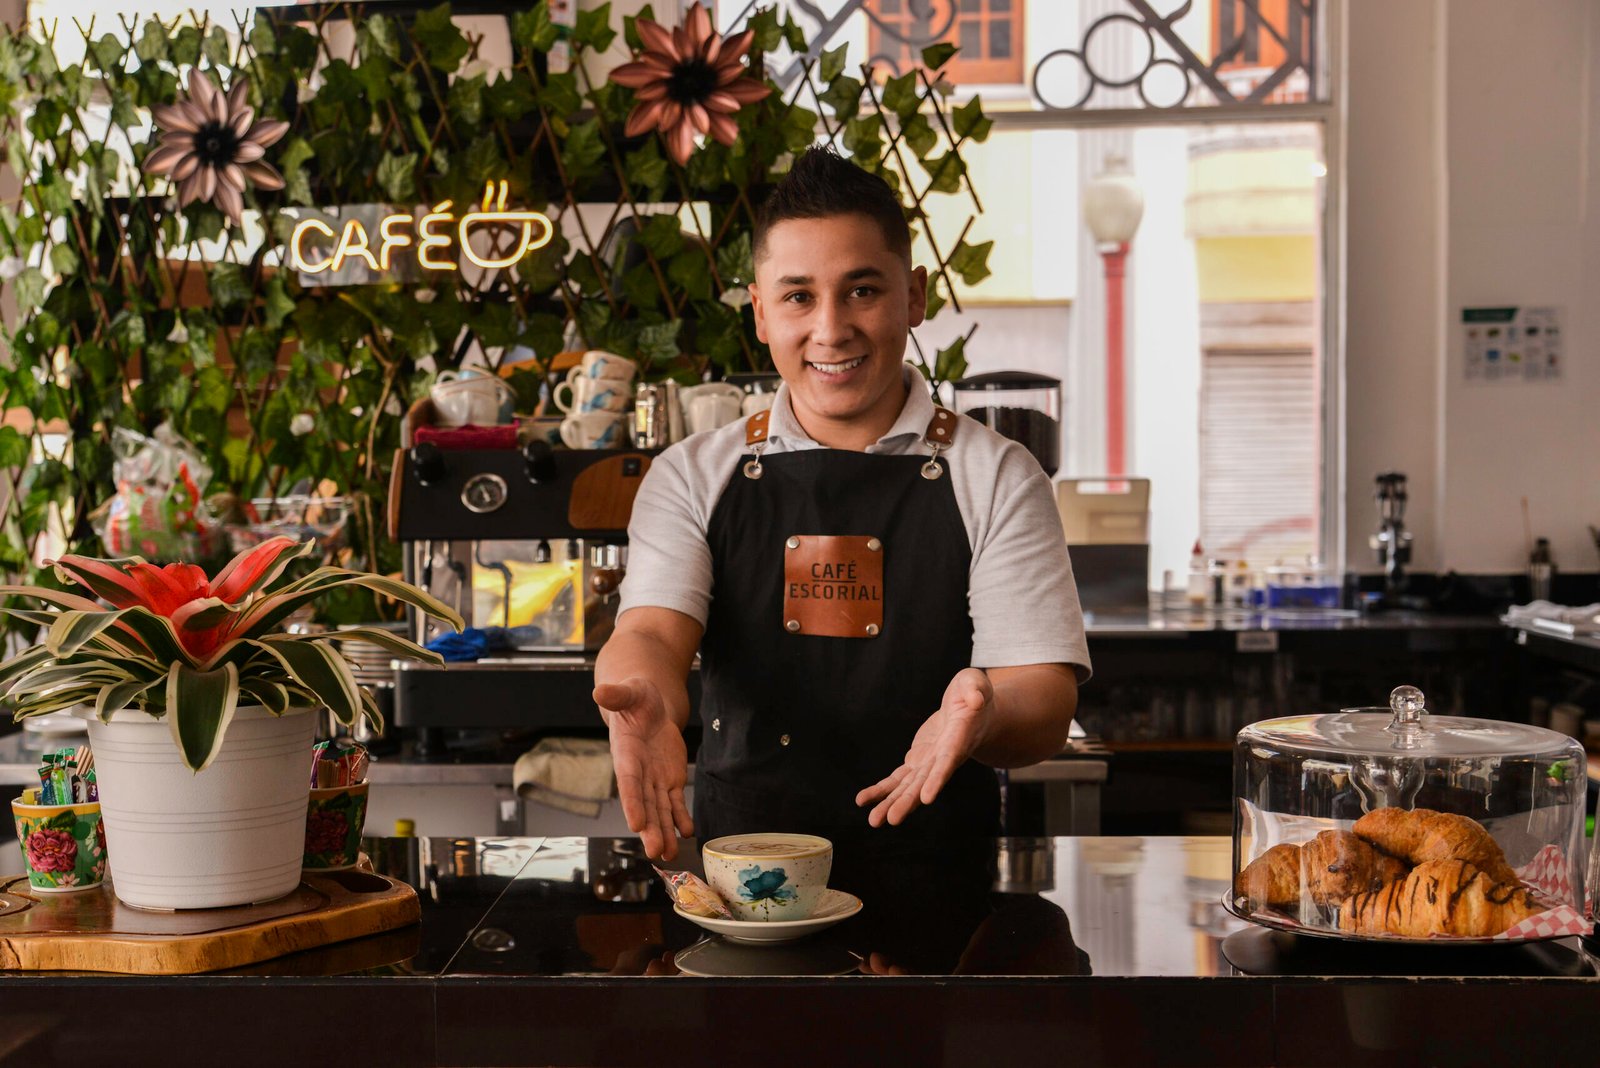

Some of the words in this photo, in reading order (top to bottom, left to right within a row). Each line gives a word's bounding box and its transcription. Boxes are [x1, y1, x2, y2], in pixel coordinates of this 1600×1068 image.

[291, 200, 457, 273] CAFÉ
[811, 561, 856, 579] CAFÉ
[789, 583, 880, 600] ESCORIAL
